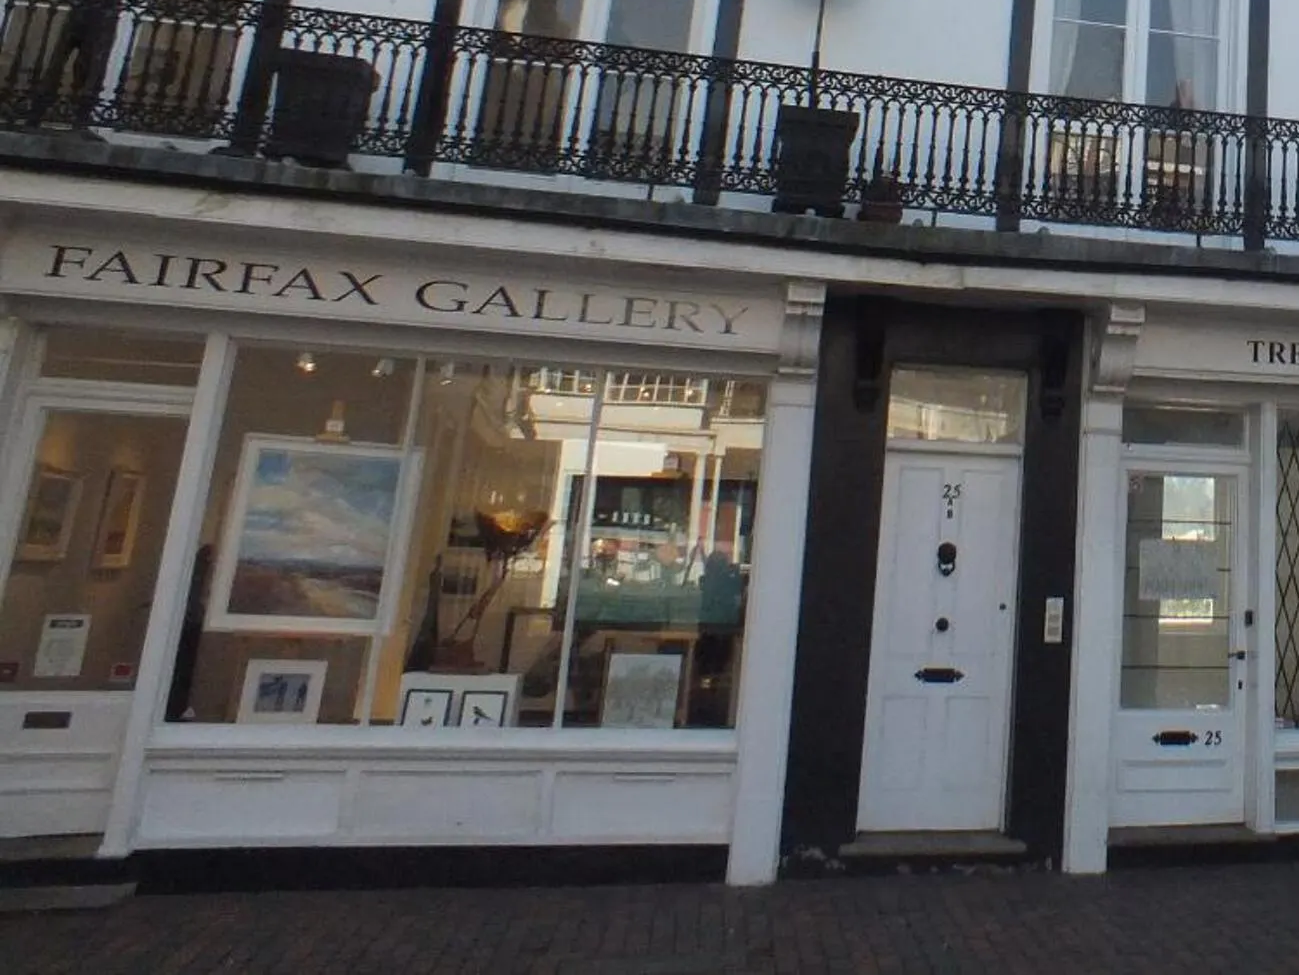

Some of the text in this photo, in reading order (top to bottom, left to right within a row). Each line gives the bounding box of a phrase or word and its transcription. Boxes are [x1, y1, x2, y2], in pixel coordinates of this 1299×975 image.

[46, 244, 750, 336] FAIRFAX GALLERY
[942, 483, 962, 499] 25
[1204, 729, 1223, 746] 25
